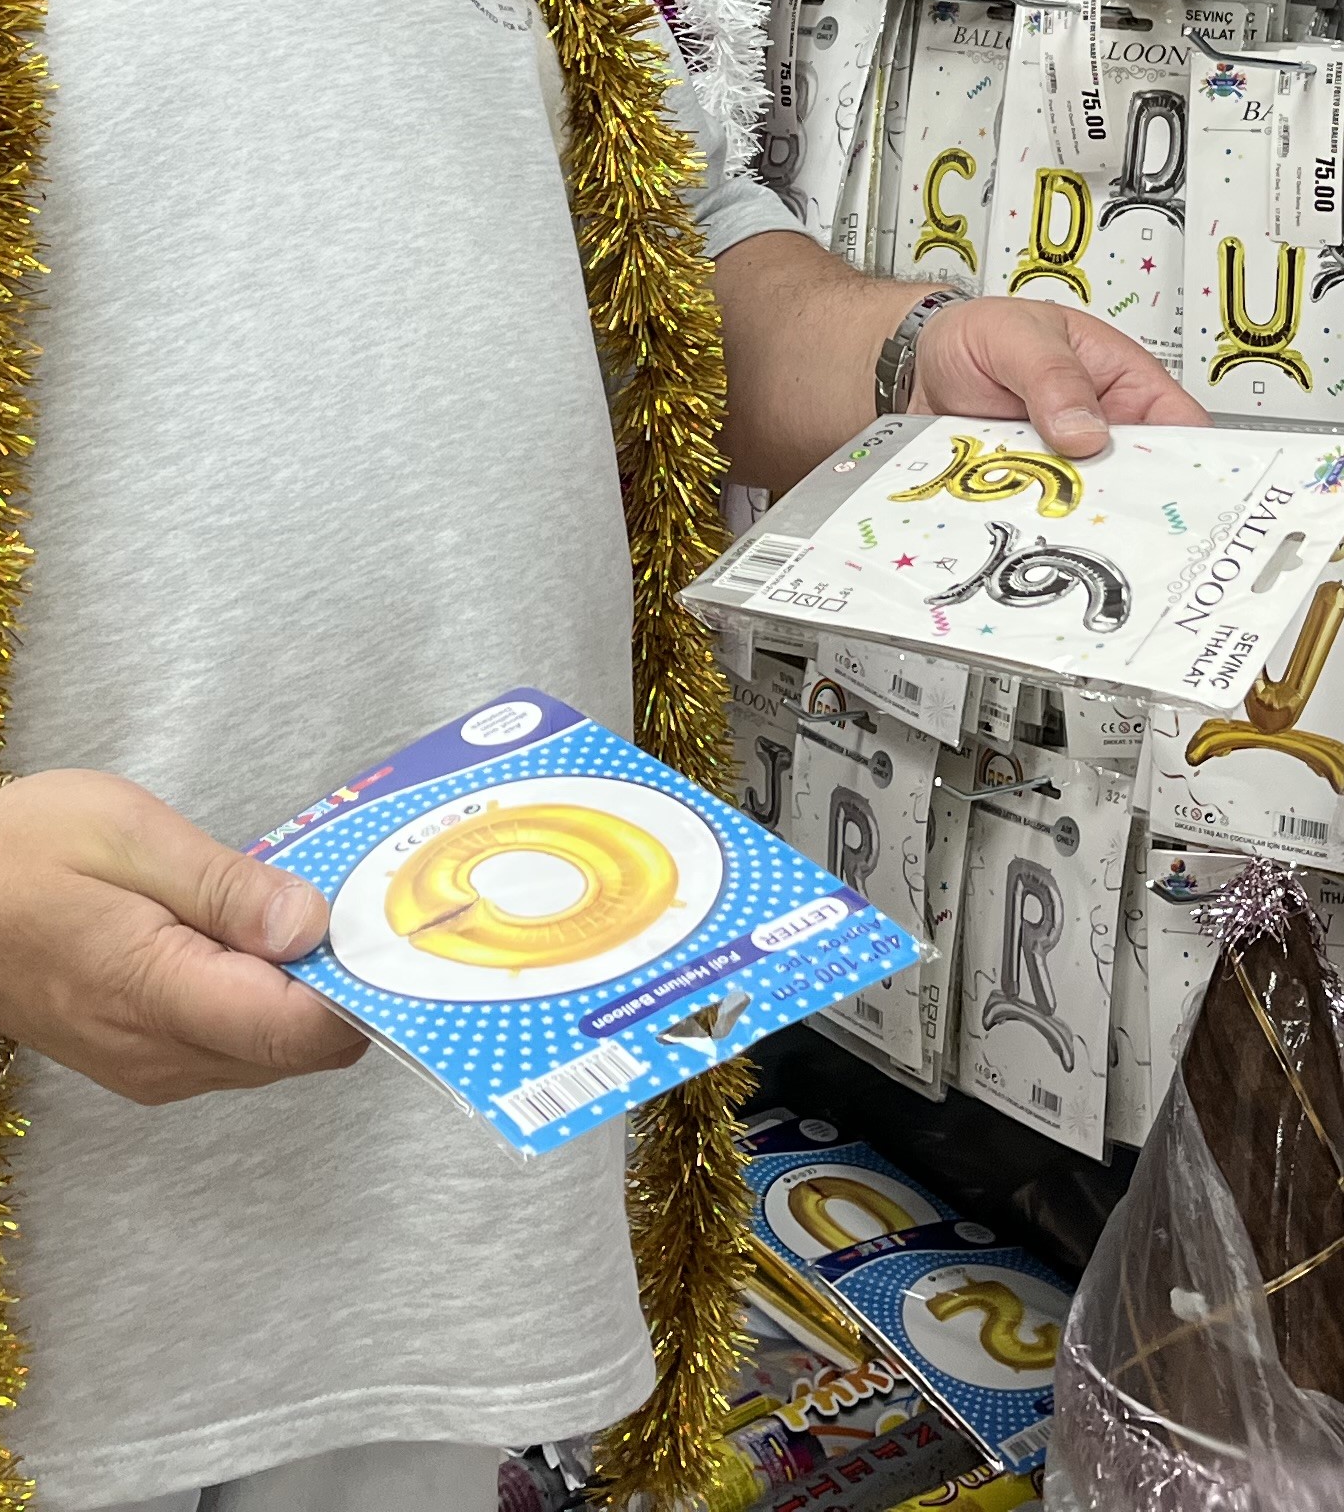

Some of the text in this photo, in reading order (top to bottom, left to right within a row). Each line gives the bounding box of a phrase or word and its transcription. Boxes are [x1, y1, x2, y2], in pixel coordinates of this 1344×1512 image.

[780, 60, 793, 109] 75.00
[1081, 89, 1106, 140] 75.00
[1314, 157, 1335, 212] 75.00
[1170, 484, 1296, 639] BALLOON
[759, 901, 848, 947] LETTER
[592, 965, 705, 1030] Helium Balloon
[770, 953, 860, 1003] 100 cm
